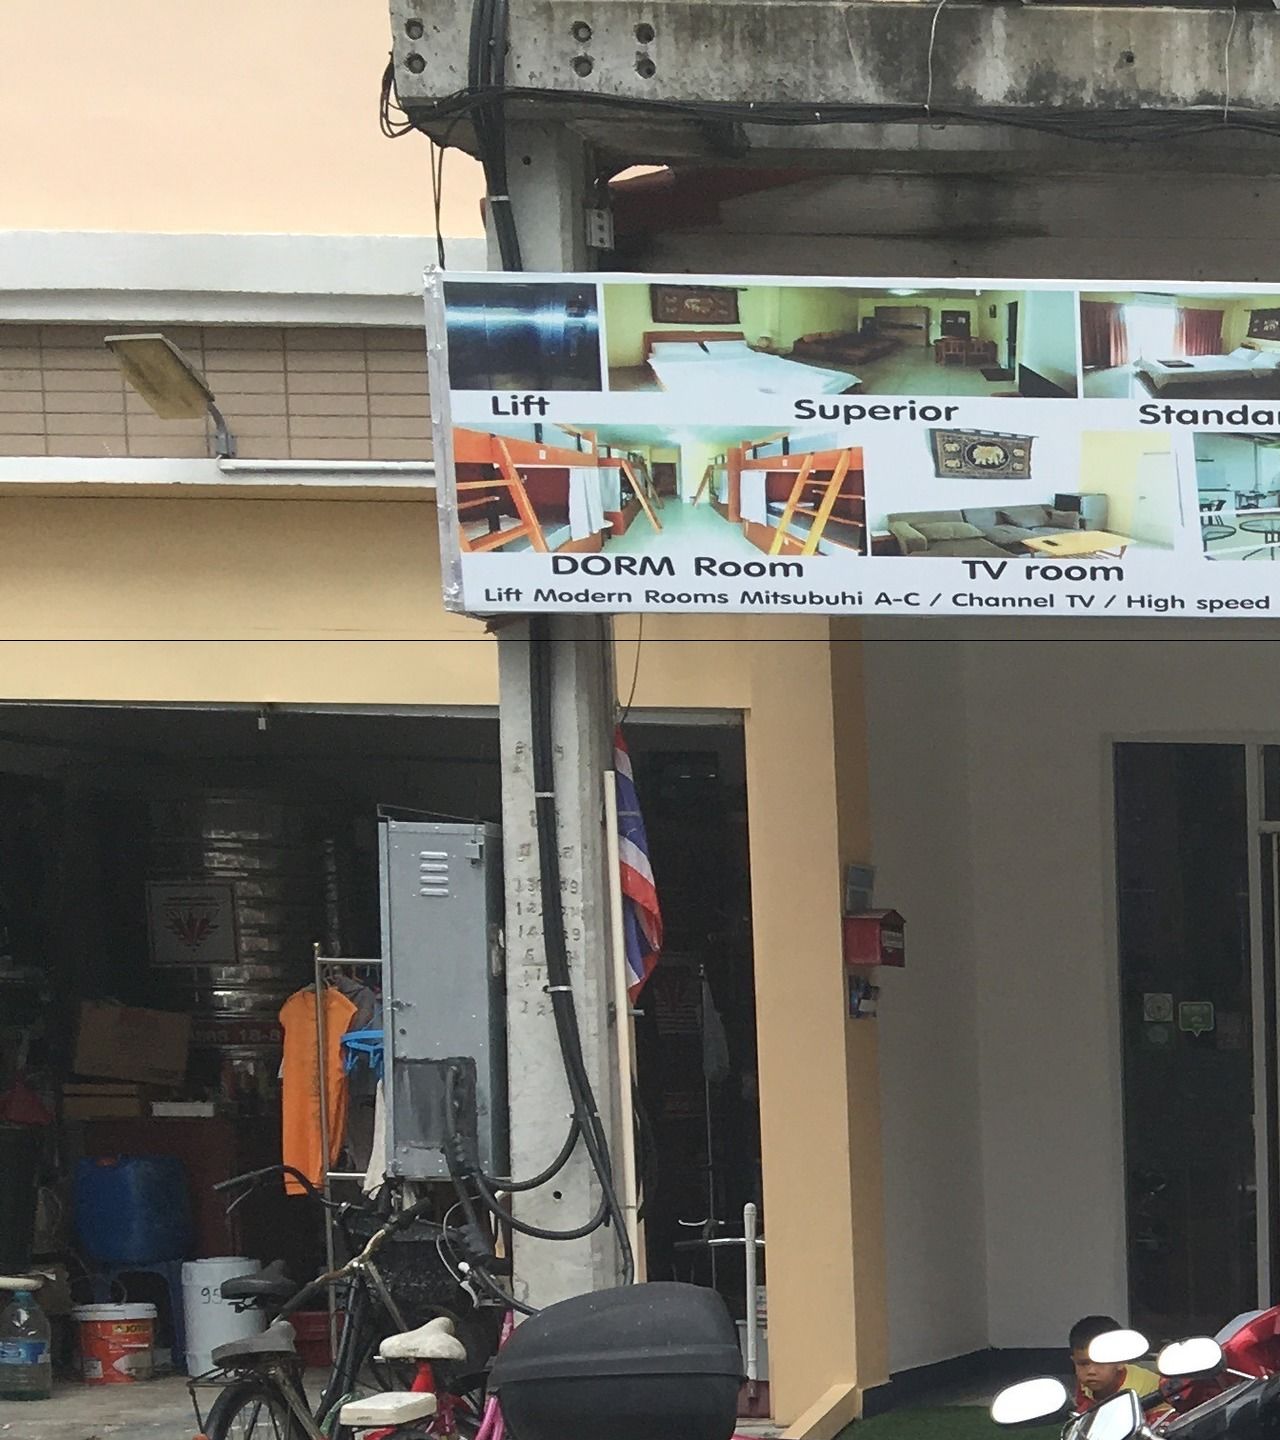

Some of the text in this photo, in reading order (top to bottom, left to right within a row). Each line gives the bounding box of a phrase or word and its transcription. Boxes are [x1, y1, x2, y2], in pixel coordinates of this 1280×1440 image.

[491, 394, 551, 417] Lift
[794, 399, 960, 426] Superior
[551, 555, 804, 578] DORM Room
[961, 559, 1124, 582] TV room
[484, 587, 523, 602] Lift
[533, 588, 633, 603] Modern
[644, 589, 729, 604] Rooms
[740, 590, 863, 606] Mitsubuhi
[874, 591, 921, 607] A-C
[951, 592, 1055, 608] Channel
[1065, 594, 1096, 609] TV
[1126, 594, 1185, 613] High
[1196, 595, 1270, 614] speed
